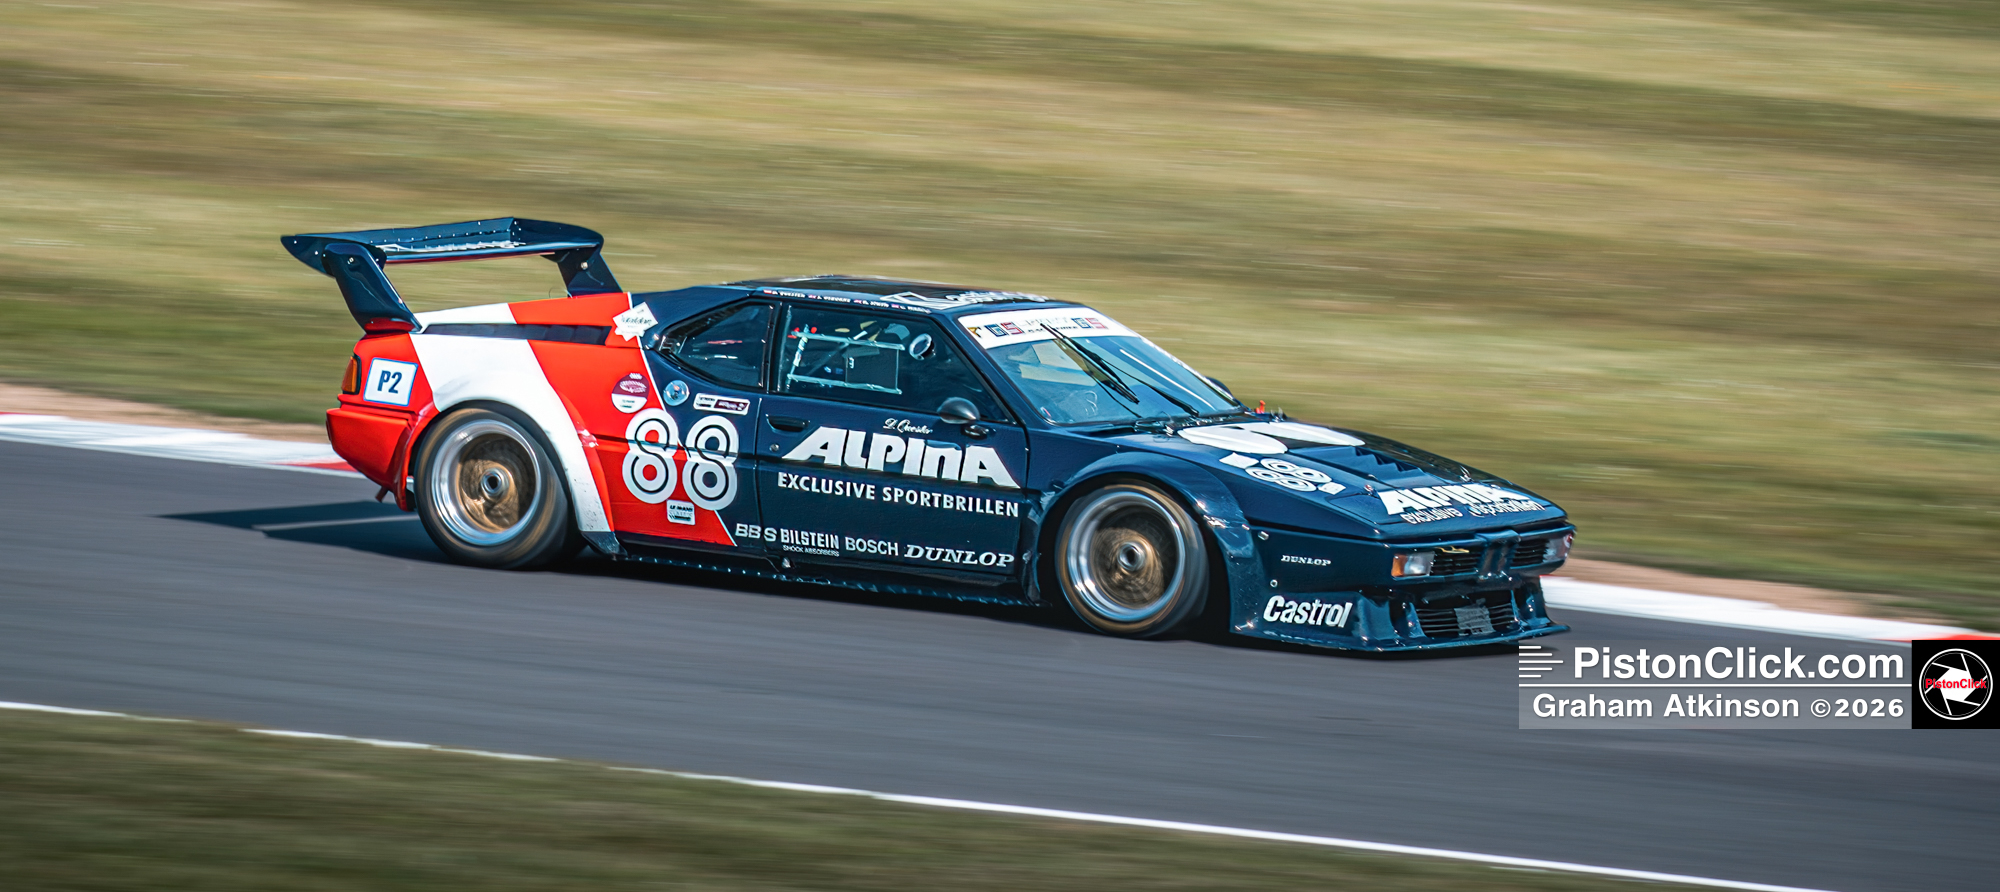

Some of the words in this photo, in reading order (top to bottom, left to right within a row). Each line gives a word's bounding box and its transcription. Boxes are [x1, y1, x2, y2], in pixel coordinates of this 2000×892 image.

[377, 370, 403, 394] P2
[622, 407, 739, 511] 88
[782, 427, 1021, 489] ALPINA
[777, 472, 876, 501] EXCLUSIVE
[882, 486, 1020, 518] SPORTBRILLEN
[735, 523, 777, 542] BBS
[780, 528, 840, 550] BILSTEIN
[845, 536, 899, 556] BOSCH
[904, 544, 1015, 567] DUNLOP
[1280, 554, 1332, 567] DUNLOP
[1263, 595, 1353, 628] Castrol
